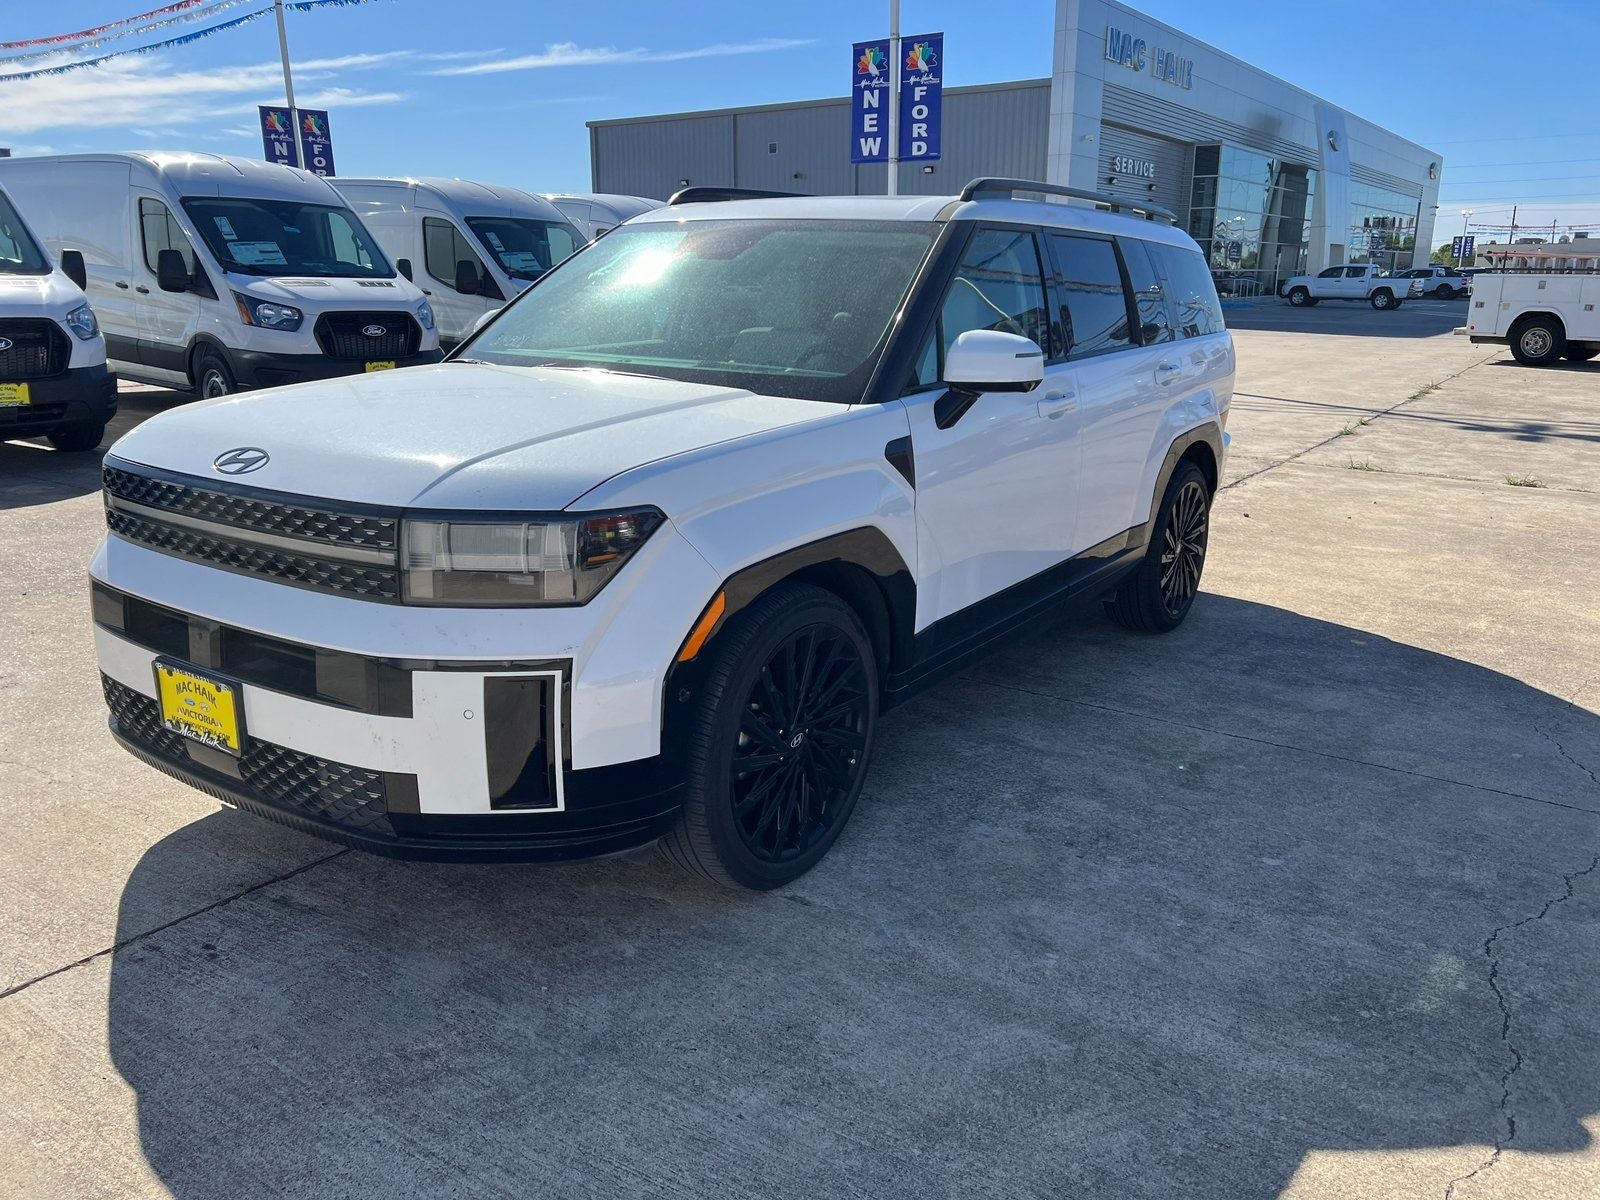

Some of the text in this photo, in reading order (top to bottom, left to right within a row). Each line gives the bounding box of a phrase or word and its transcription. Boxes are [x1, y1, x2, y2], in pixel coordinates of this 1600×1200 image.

[1105, 26, 1194, 90] MAC HAIK
[860, 89, 881, 156] NEW
[912, 86, 928, 156] FORD
[1115, 156, 1154, 178] SERVICE
[367, 326, 382, 334] Ford
[176, 681, 217, 708] MAC HAIK
[182, 708, 216, 726] VICTORIA
[180, 725, 221, 747] Mac Haik
